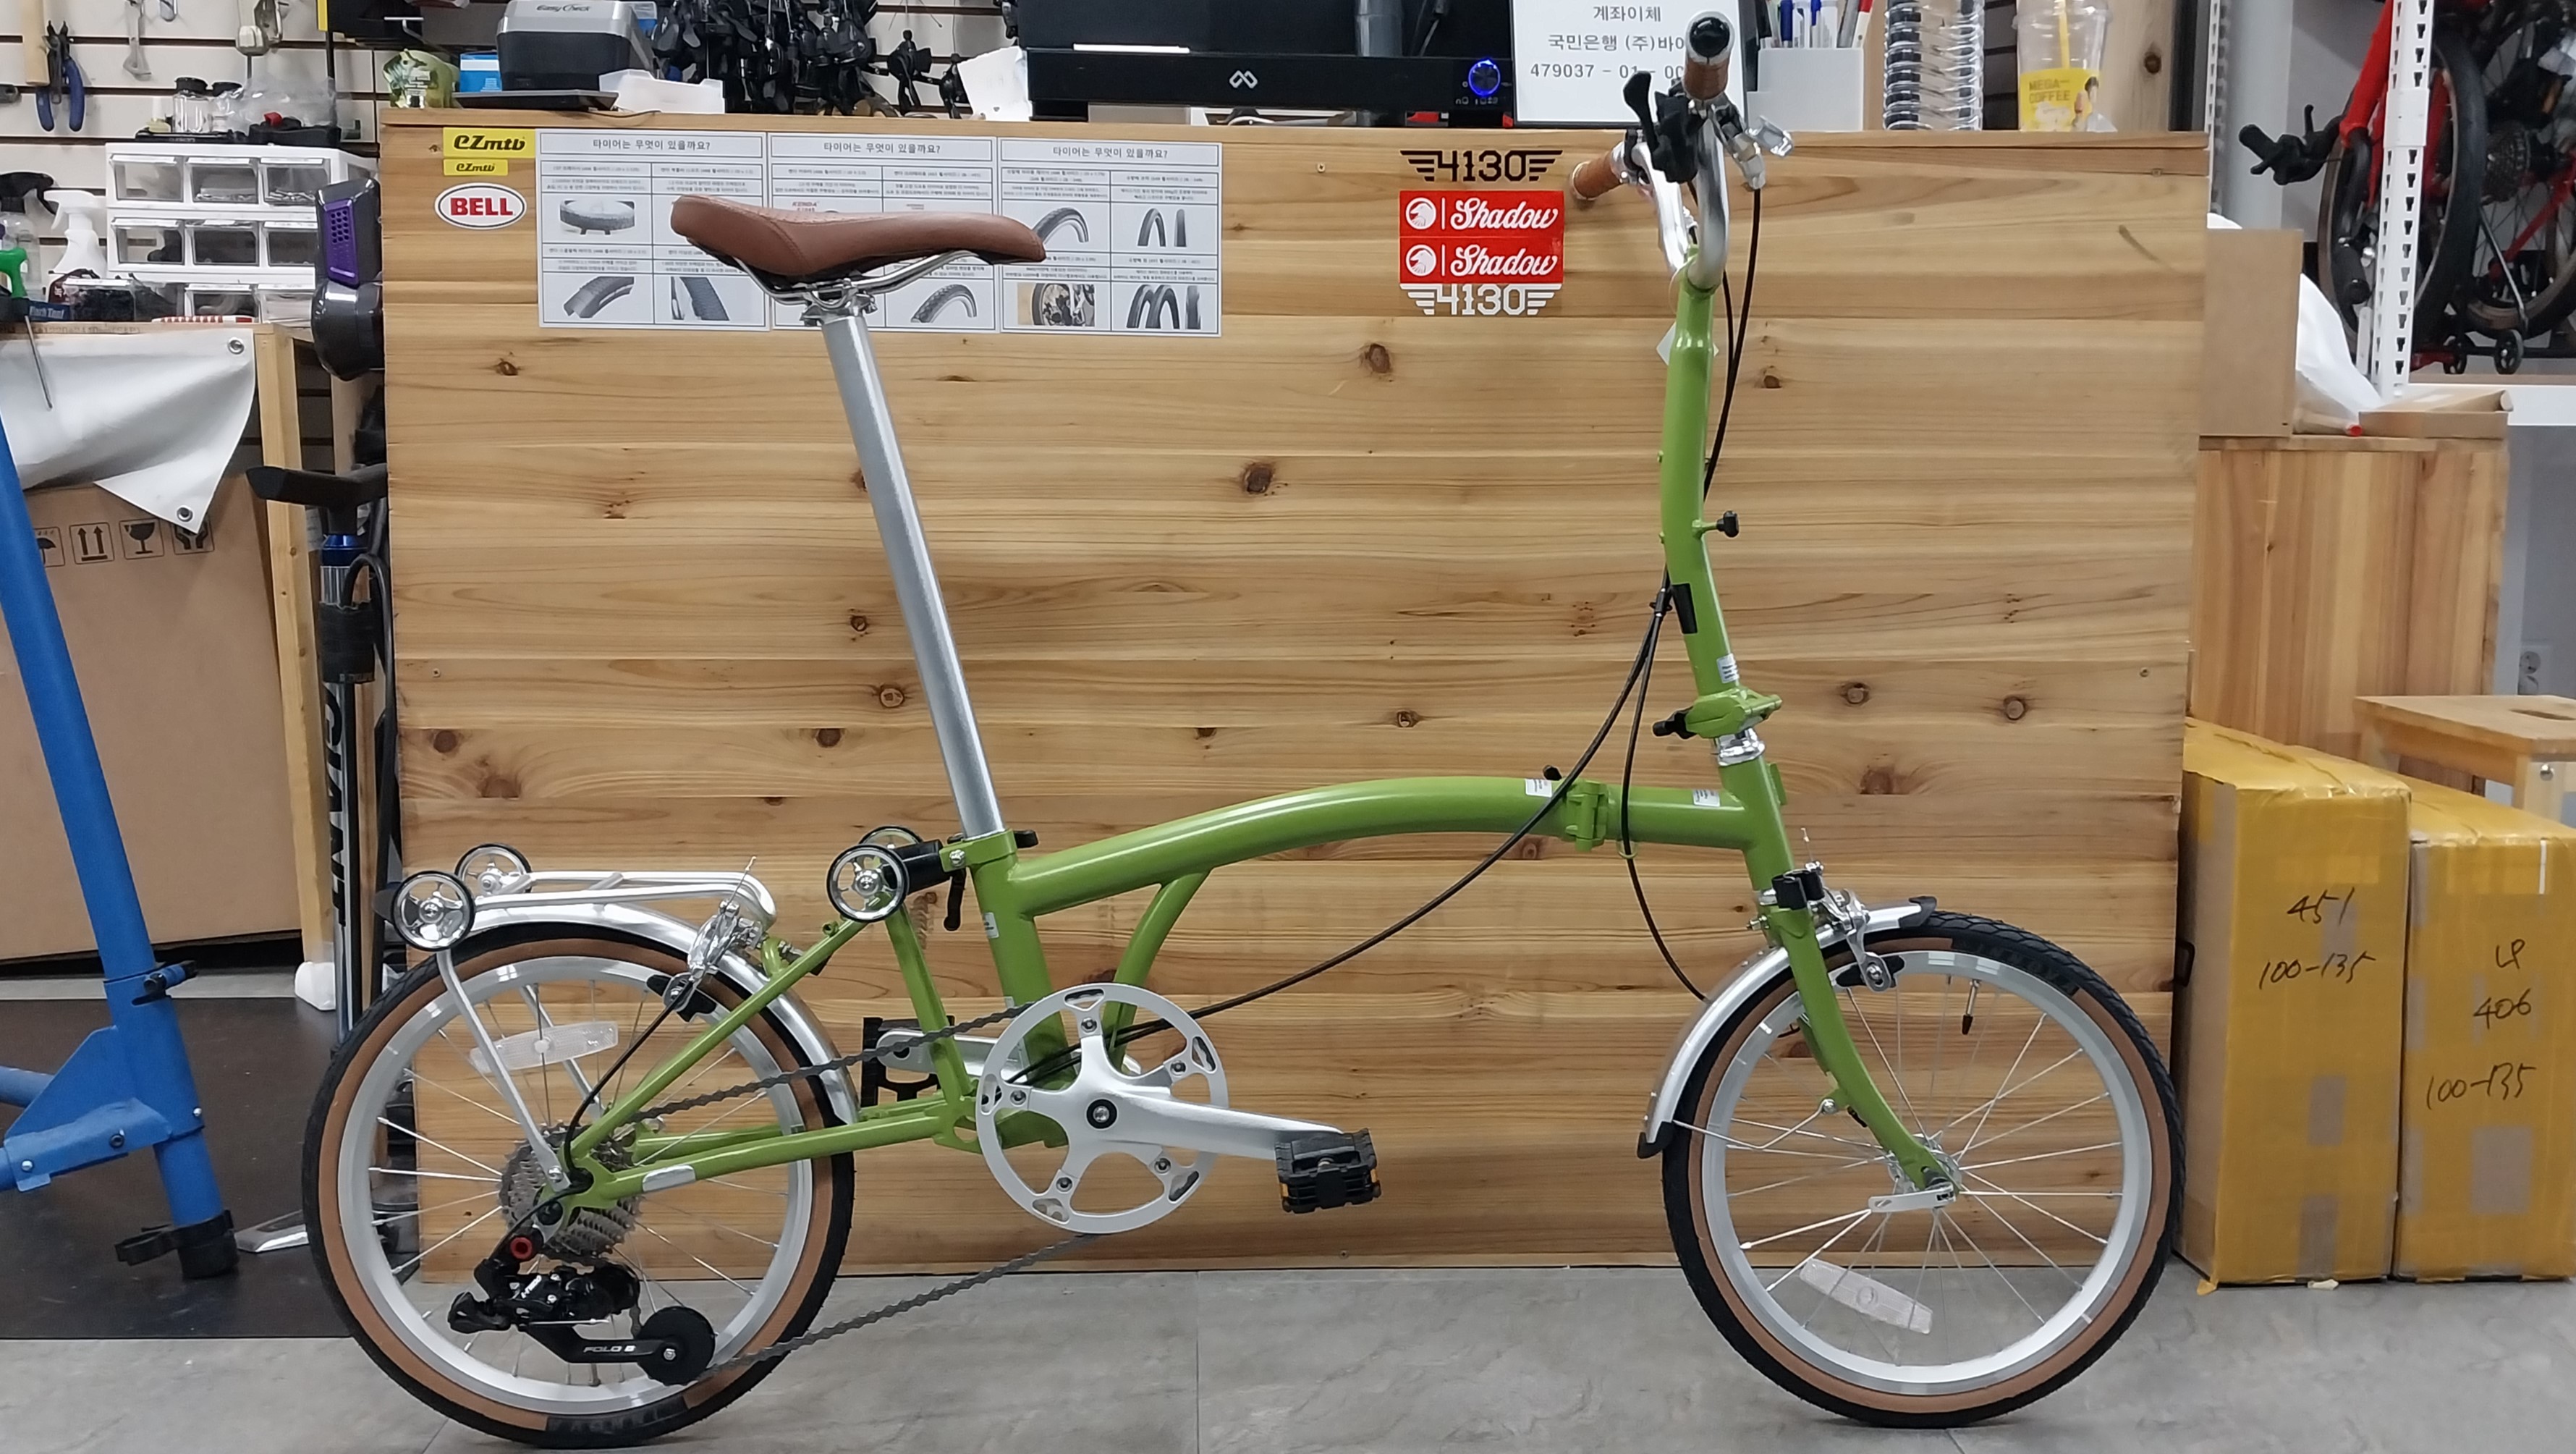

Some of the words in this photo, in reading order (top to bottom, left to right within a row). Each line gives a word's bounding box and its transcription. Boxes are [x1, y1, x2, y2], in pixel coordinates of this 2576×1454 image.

[1593, 5, 1661, 22] 계좌이체
[1548, 34, 1617, 51] 국민은행
[1530, 64, 1595, 77] 479037
[2029, 90, 2070, 103] COFFEE
[593, 138, 632, 150] 타이어는
[635, 139, 664, 150] 무엇이
[667, 140, 711, 151] 있을까요?
[823, 142, 861, 153] 타이어는
[865, 143, 894, 154] 무엇이
[898, 143, 941, 155] 있을까요?
[1053, 146, 1090, 157] 타이어는
[1094, 147, 1122, 158] 무엇이
[1126, 148, 1168, 159] 있을까요?
[450, 198, 513, 216] BELL
[1450, 197, 1559, 230] Shadow
[1450, 244, 1558, 276] Shadow
[2287, 887, 2355, 926] 451
[2259, 950, 2376, 989] 100-135
[2473, 988, 2531, 1030] 406
[2426, 1062, 2537, 1110] 100-135
